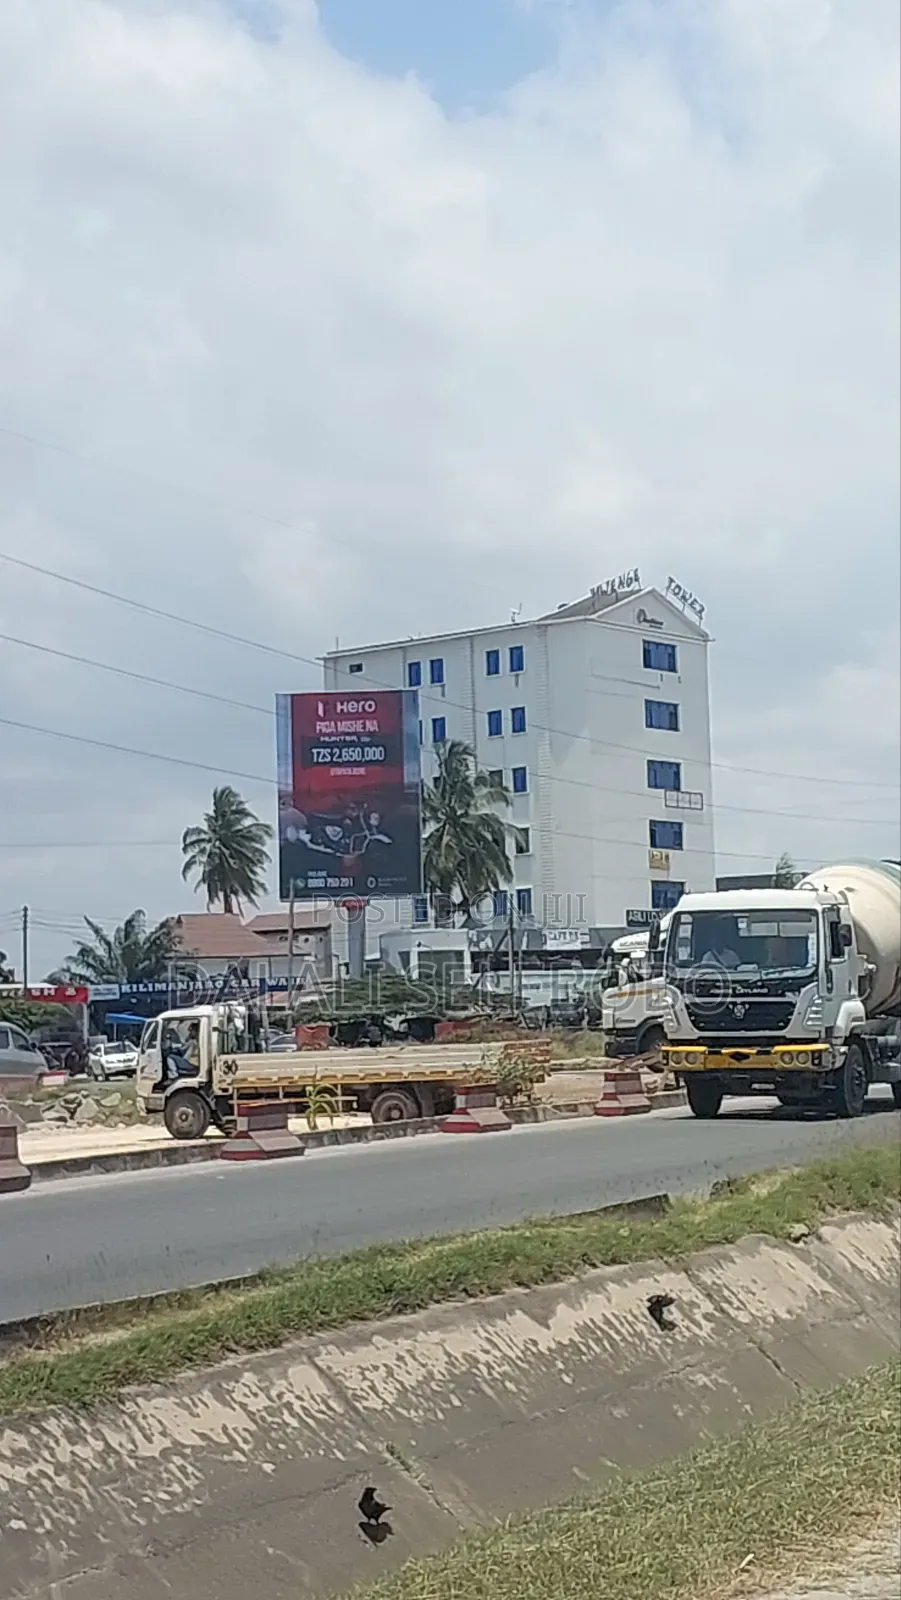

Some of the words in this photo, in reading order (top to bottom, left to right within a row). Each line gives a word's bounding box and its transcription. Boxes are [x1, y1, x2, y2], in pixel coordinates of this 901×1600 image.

[366, 719, 379, 732] NA
[311, 748, 331, 763] TZS
[332, 746, 386, 762] 2,650,000
[121, 980, 224, 994] KILIMANJARO
[222, 1060, 239, 1076] 30
